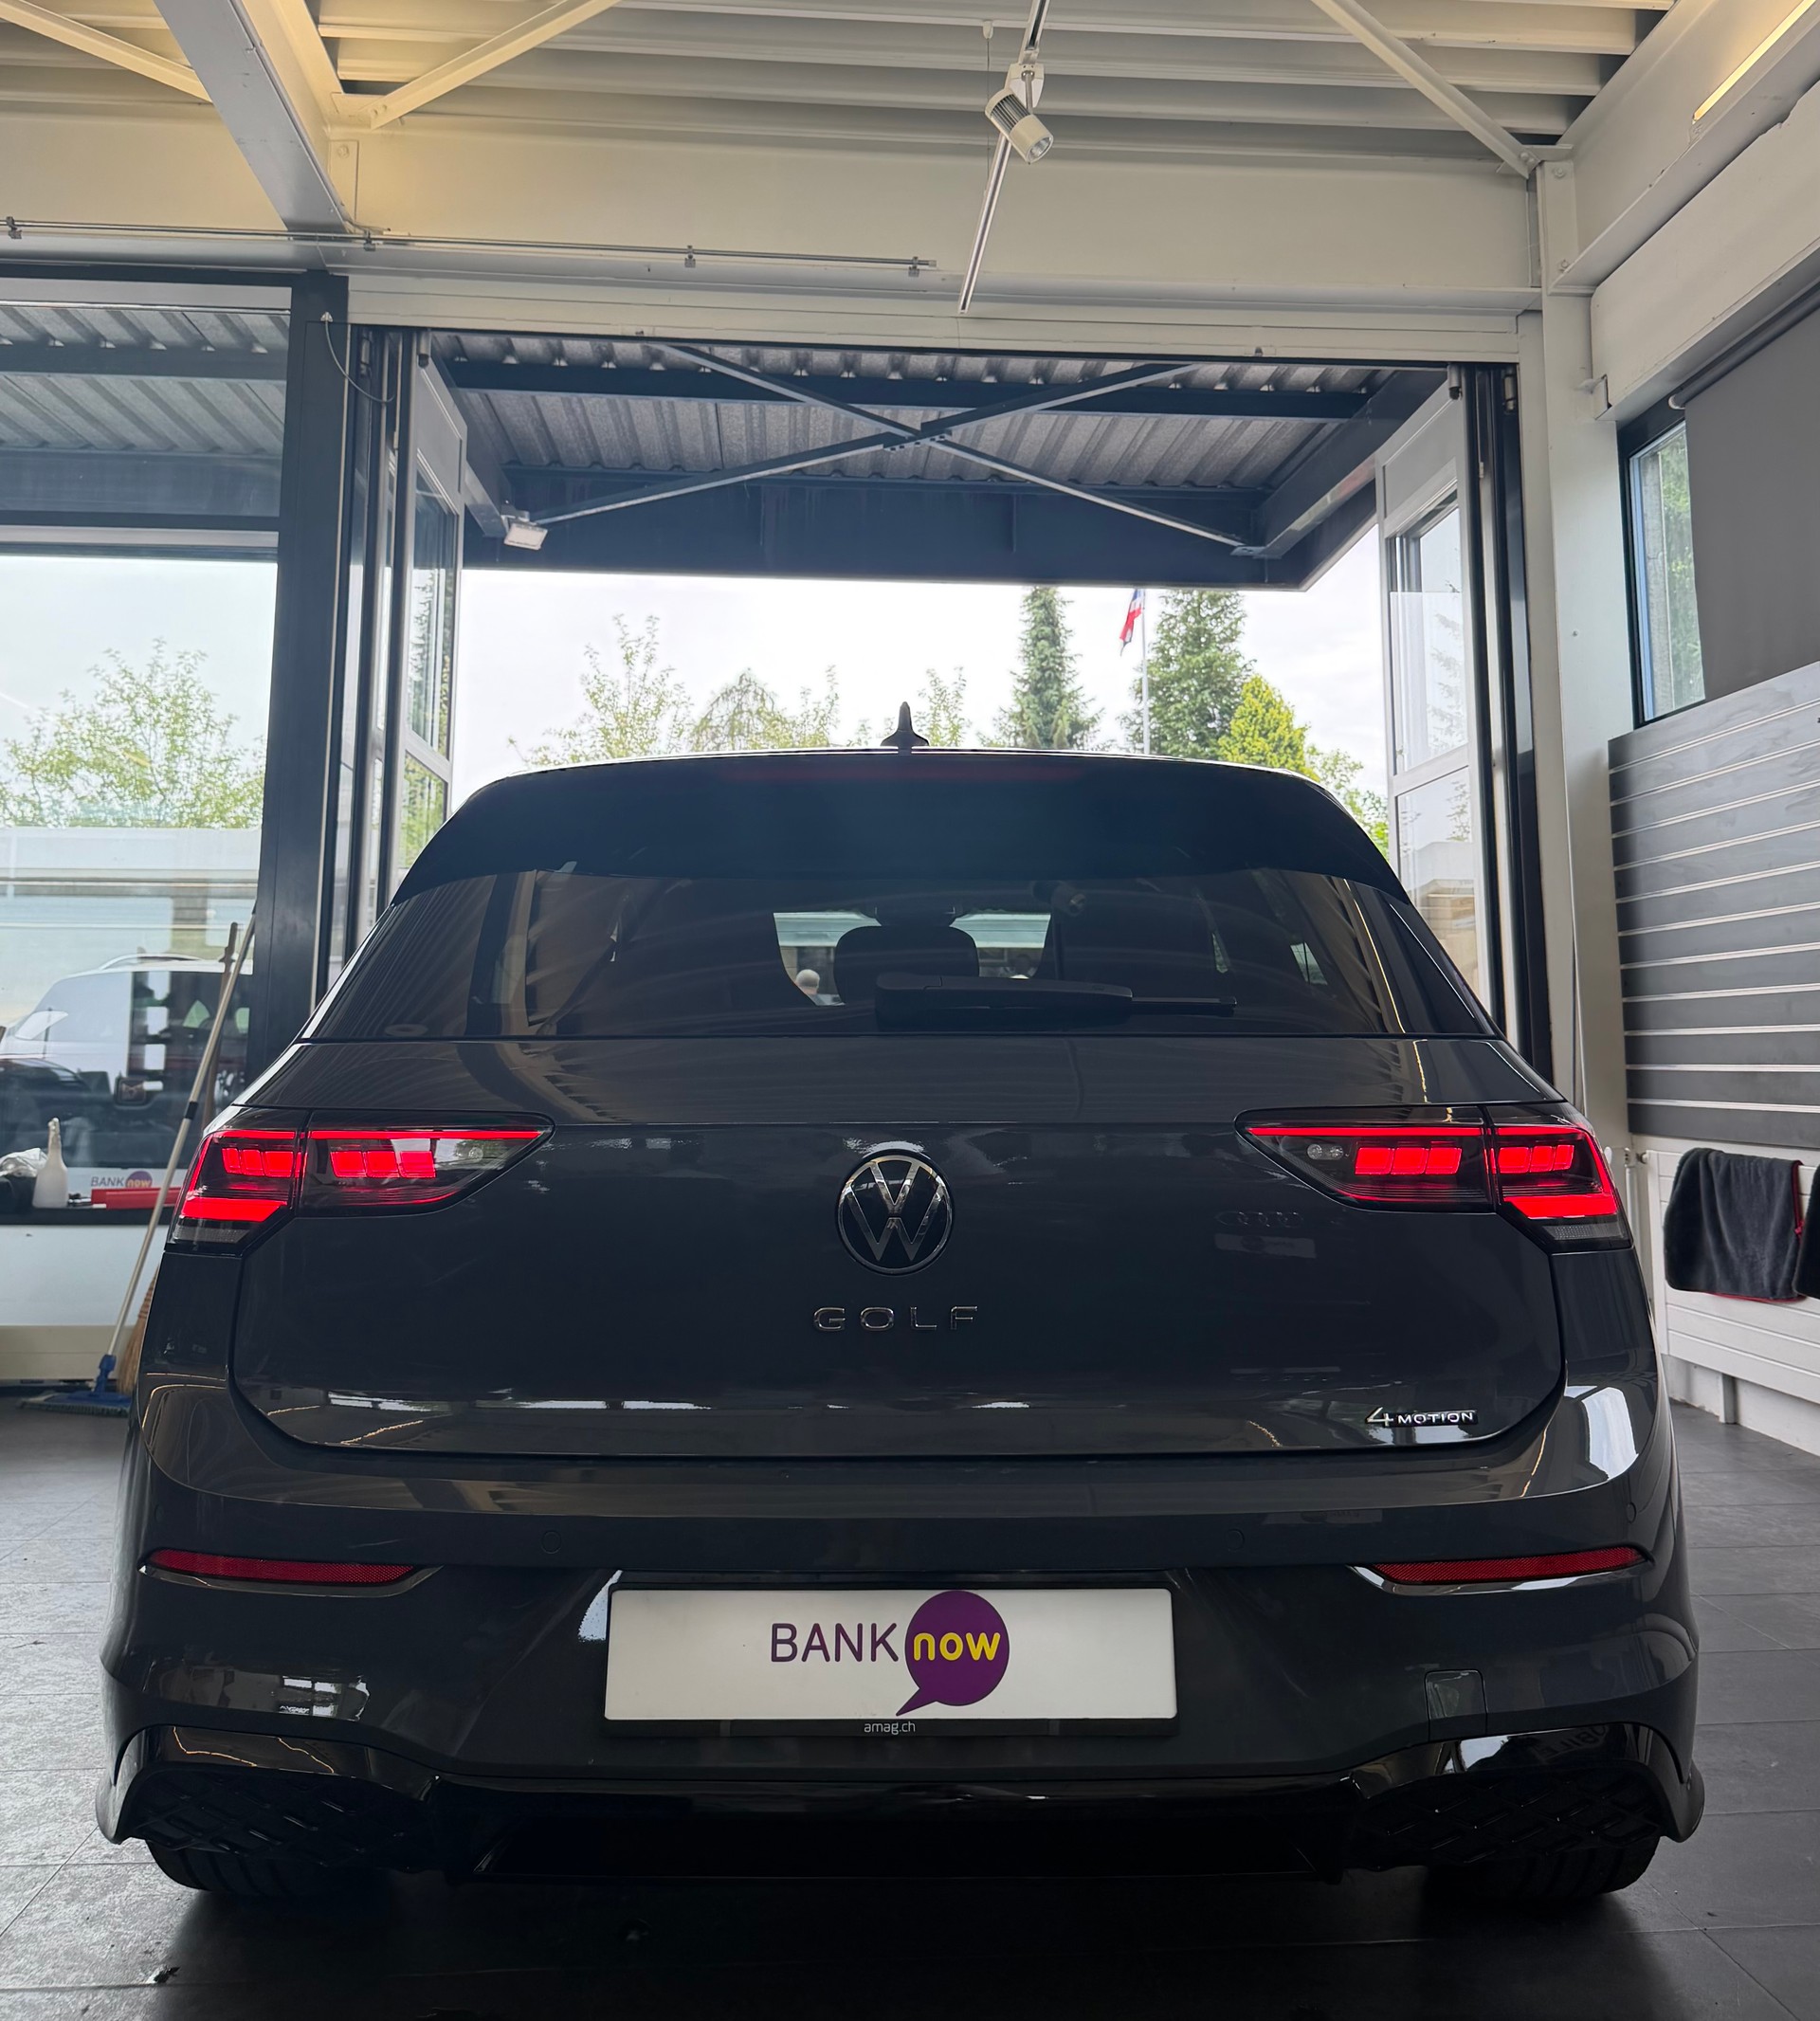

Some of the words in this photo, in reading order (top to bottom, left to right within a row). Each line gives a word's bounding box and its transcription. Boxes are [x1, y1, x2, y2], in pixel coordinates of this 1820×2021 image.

[91, 1176, 124, 1187] BANK
[127, 1179, 151, 1188] now
[813, 1306, 977, 1331] GOLF
[771, 1622, 900, 1663] BANK
[913, 1632, 1001, 1661] now
[864, 1721, 916, 1736] amag.ch
